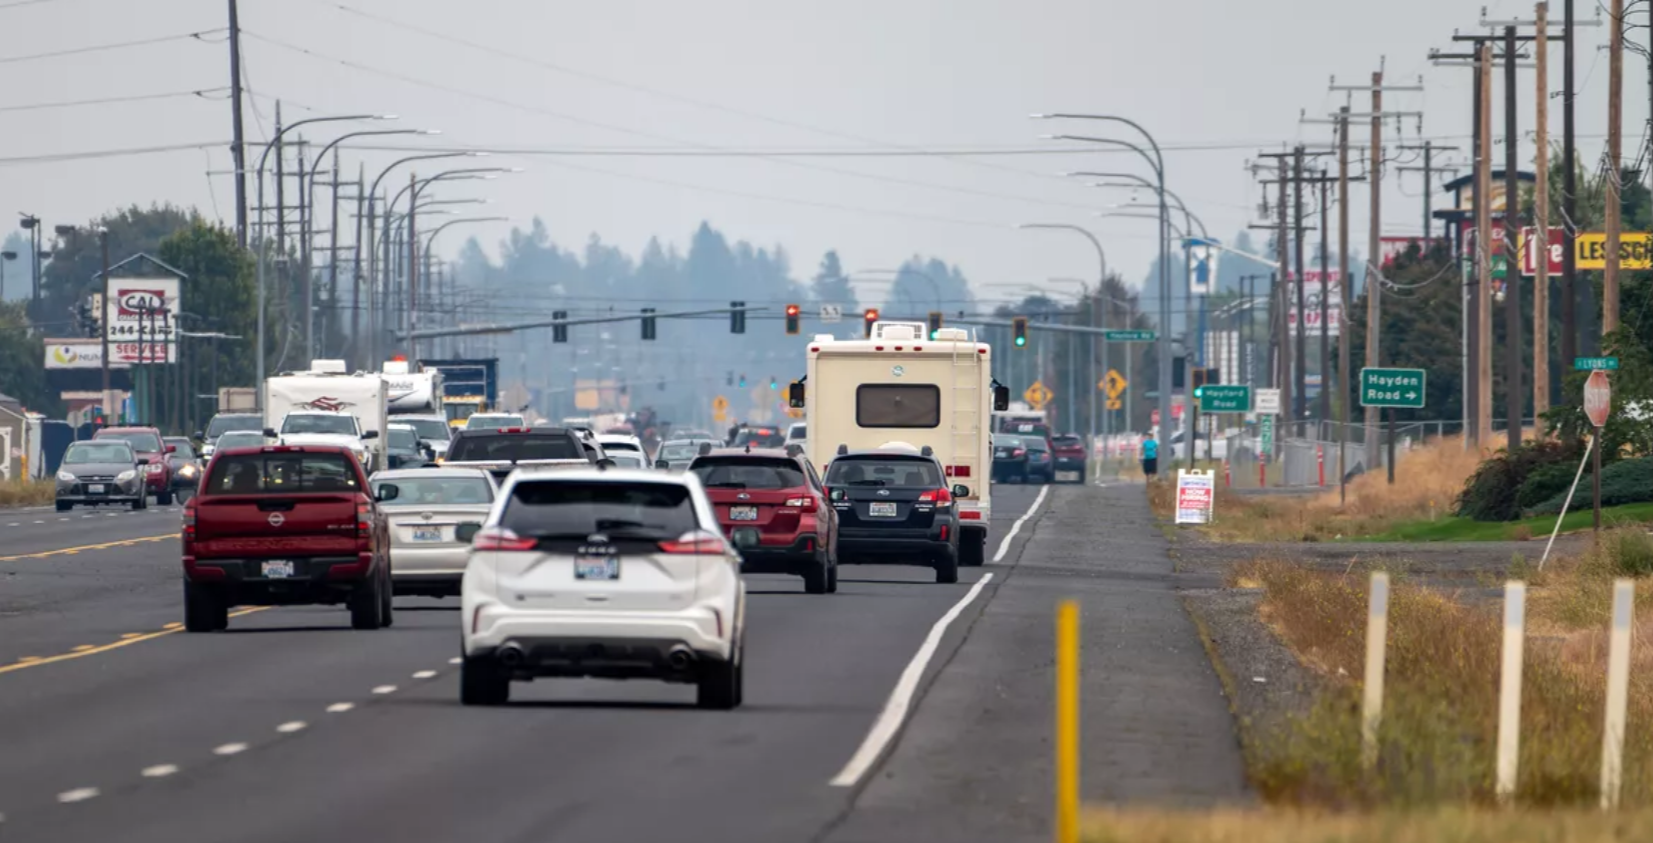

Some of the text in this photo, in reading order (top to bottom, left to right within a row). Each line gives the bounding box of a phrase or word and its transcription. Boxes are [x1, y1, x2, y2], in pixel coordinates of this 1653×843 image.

[1583, 359, 1607, 369] LYONS
[1368, 374, 1418, 387] Hayden
[1205, 389, 1244, 398] Hayford
[1367, 389, 1401, 400] Road
[1212, 400, 1237, 408] Road
